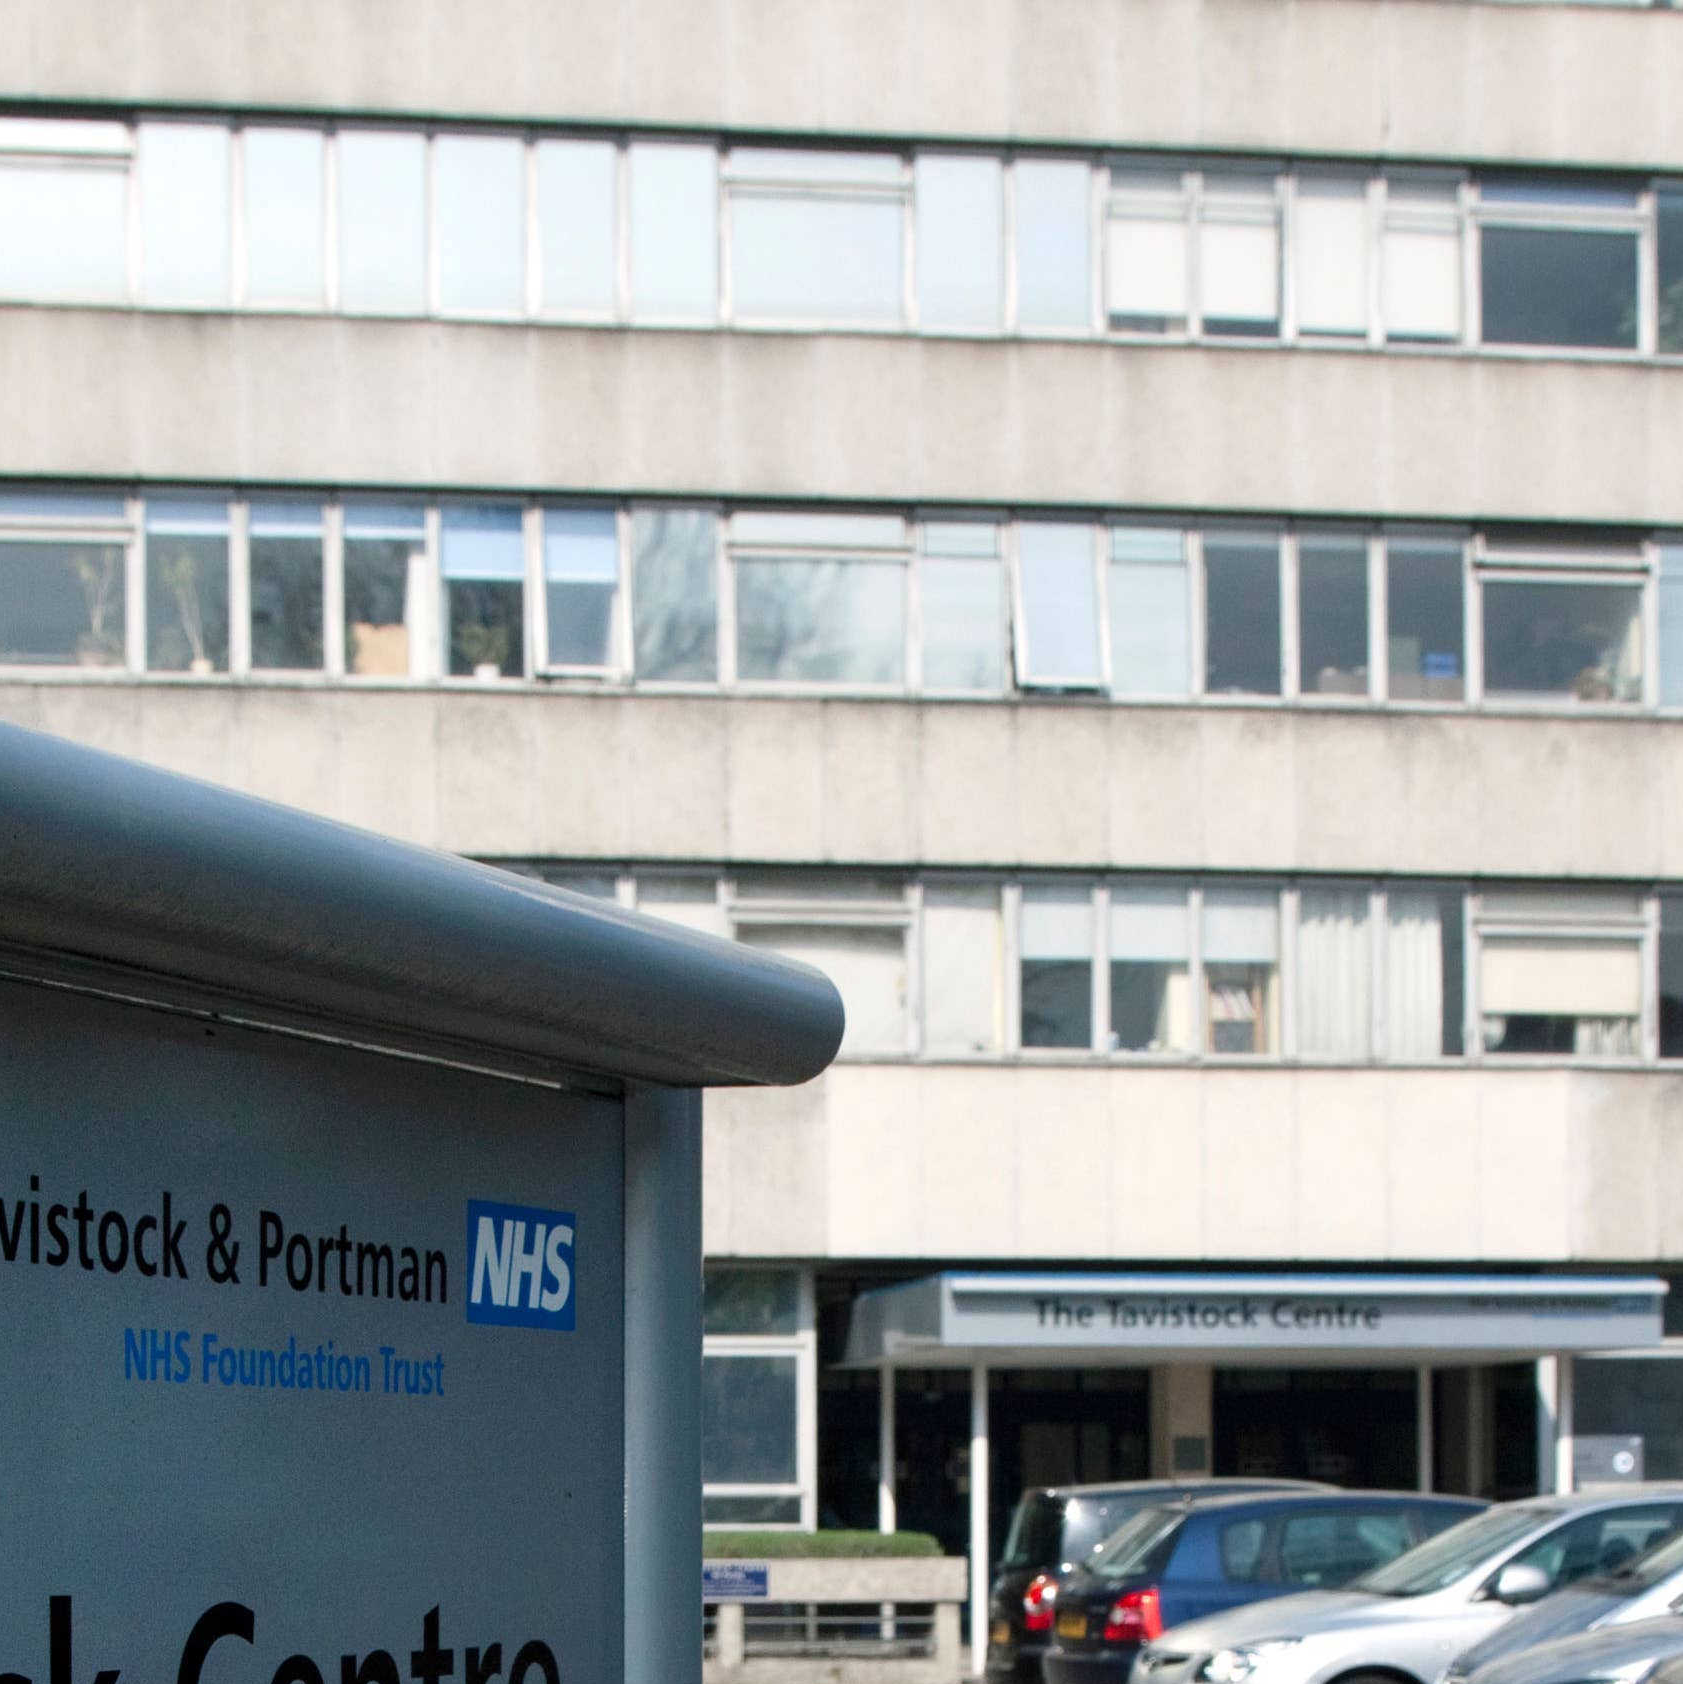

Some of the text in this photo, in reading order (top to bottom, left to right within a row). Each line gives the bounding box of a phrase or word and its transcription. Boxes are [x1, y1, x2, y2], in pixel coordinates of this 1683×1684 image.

[206, 1203, 240, 1284] &
[260, 1211, 447, 1303] Portman
[470, 1215, 574, 1313] NHS
[1034, 1299, 1383, 1330] The Tavistock Centre
[124, 1328, 445, 1396] NHS Foundation Trust
